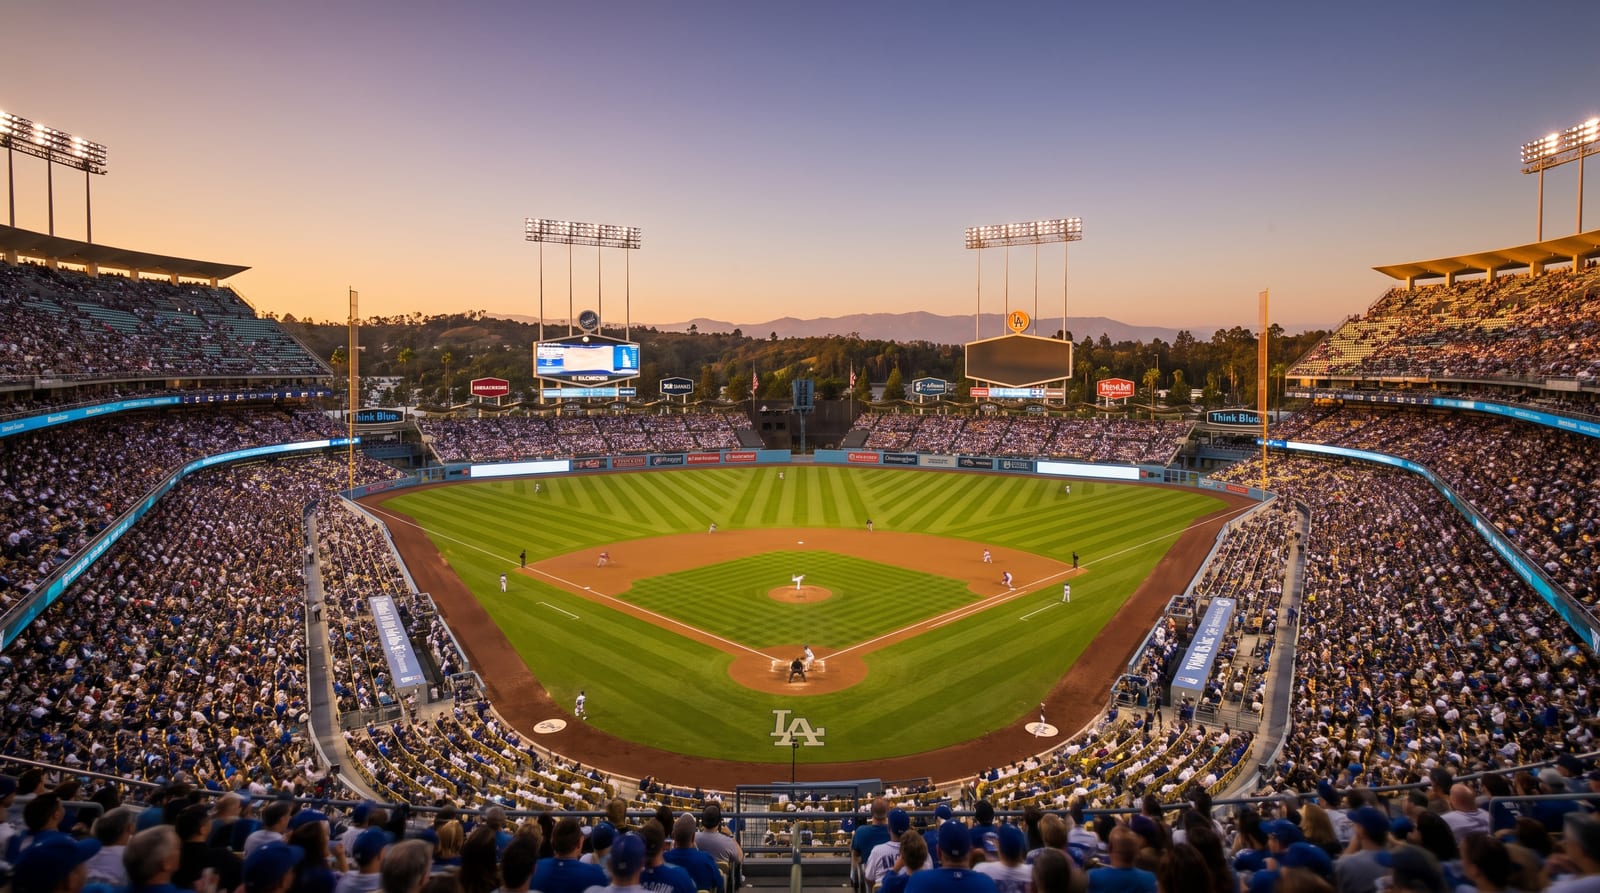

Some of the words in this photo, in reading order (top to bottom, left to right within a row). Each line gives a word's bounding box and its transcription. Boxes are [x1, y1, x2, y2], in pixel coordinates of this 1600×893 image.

[1013, 314, 1024, 328] LA
[1212, 412, 1237, 423] Think
[770, 709, 825, 746] LA
